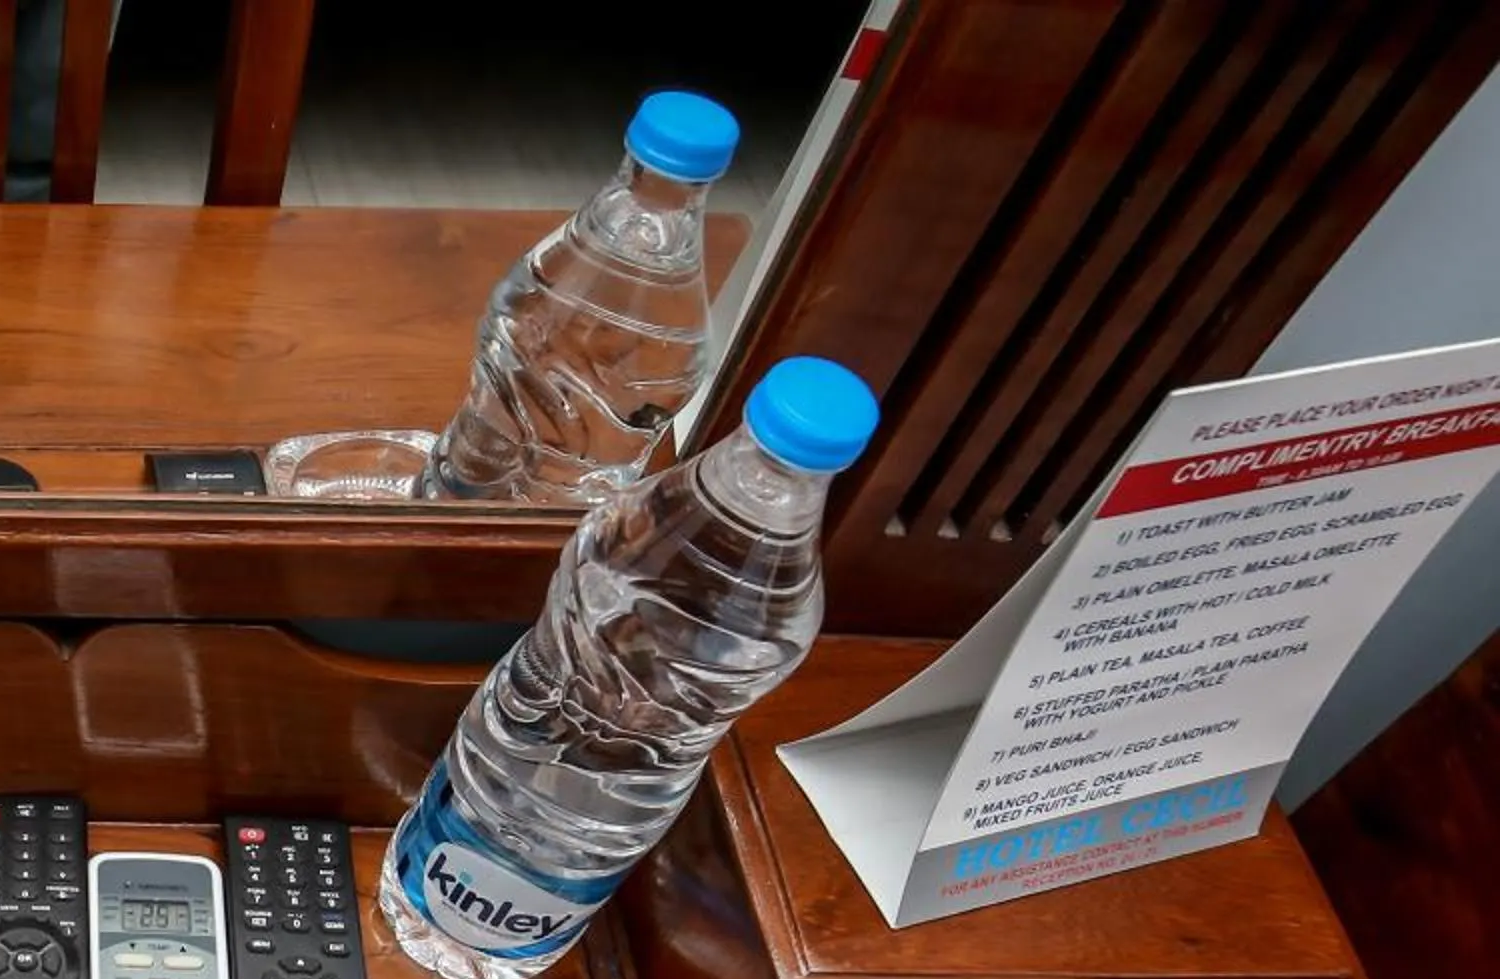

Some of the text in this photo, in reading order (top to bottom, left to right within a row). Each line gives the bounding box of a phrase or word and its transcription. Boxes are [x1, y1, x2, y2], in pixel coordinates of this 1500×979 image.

[1191, 413, 1266, 442] PLEASE
[1267, 404, 1327, 427] PLACE
[1329, 396, 1380, 420] YOUR
[1379, 385, 1442, 409] ORDER
[1172, 429, 1387, 484] COMPLIMENTRY
[1112, 493, 1464, 575] BOILED FRIED SCRAMBLED EGG
[1137, 519, 1195, 542] TOAST
[1195, 511, 1242, 529] WITH
[1241, 496, 1314, 520] BUTTER
[1312, 488, 1353, 507] JAM
[1091, 531, 1401, 605] PLAIN MASALA OMELETTE
[1063, 618, 1179, 653] WITH BANANA
[1070, 573, 1334, 638] CEREALS WITH HOT COLD MILK
[1029, 641, 1309, 715] STUFFED PARATHA PLAIN PARATHA
[1046, 615, 1311, 685] PLAIN MASALA COFFEE
[1022, 674, 1227, 730] WITH YOGURT AND PICKLE
[994, 718, 1240, 787] VEG SANDWICH EGG SANDWICH
[1008, 741, 1049, 760] PURI
[973, 782, 1125, 831] MIXED FRUITS JUICE
[980, 751, 1203, 815] MANGO ORANGE JUICE
[956, 813, 1099, 880] HOTEL
[1120, 775, 1249, 835] CECIL
[428, 852, 573, 940] kinley
